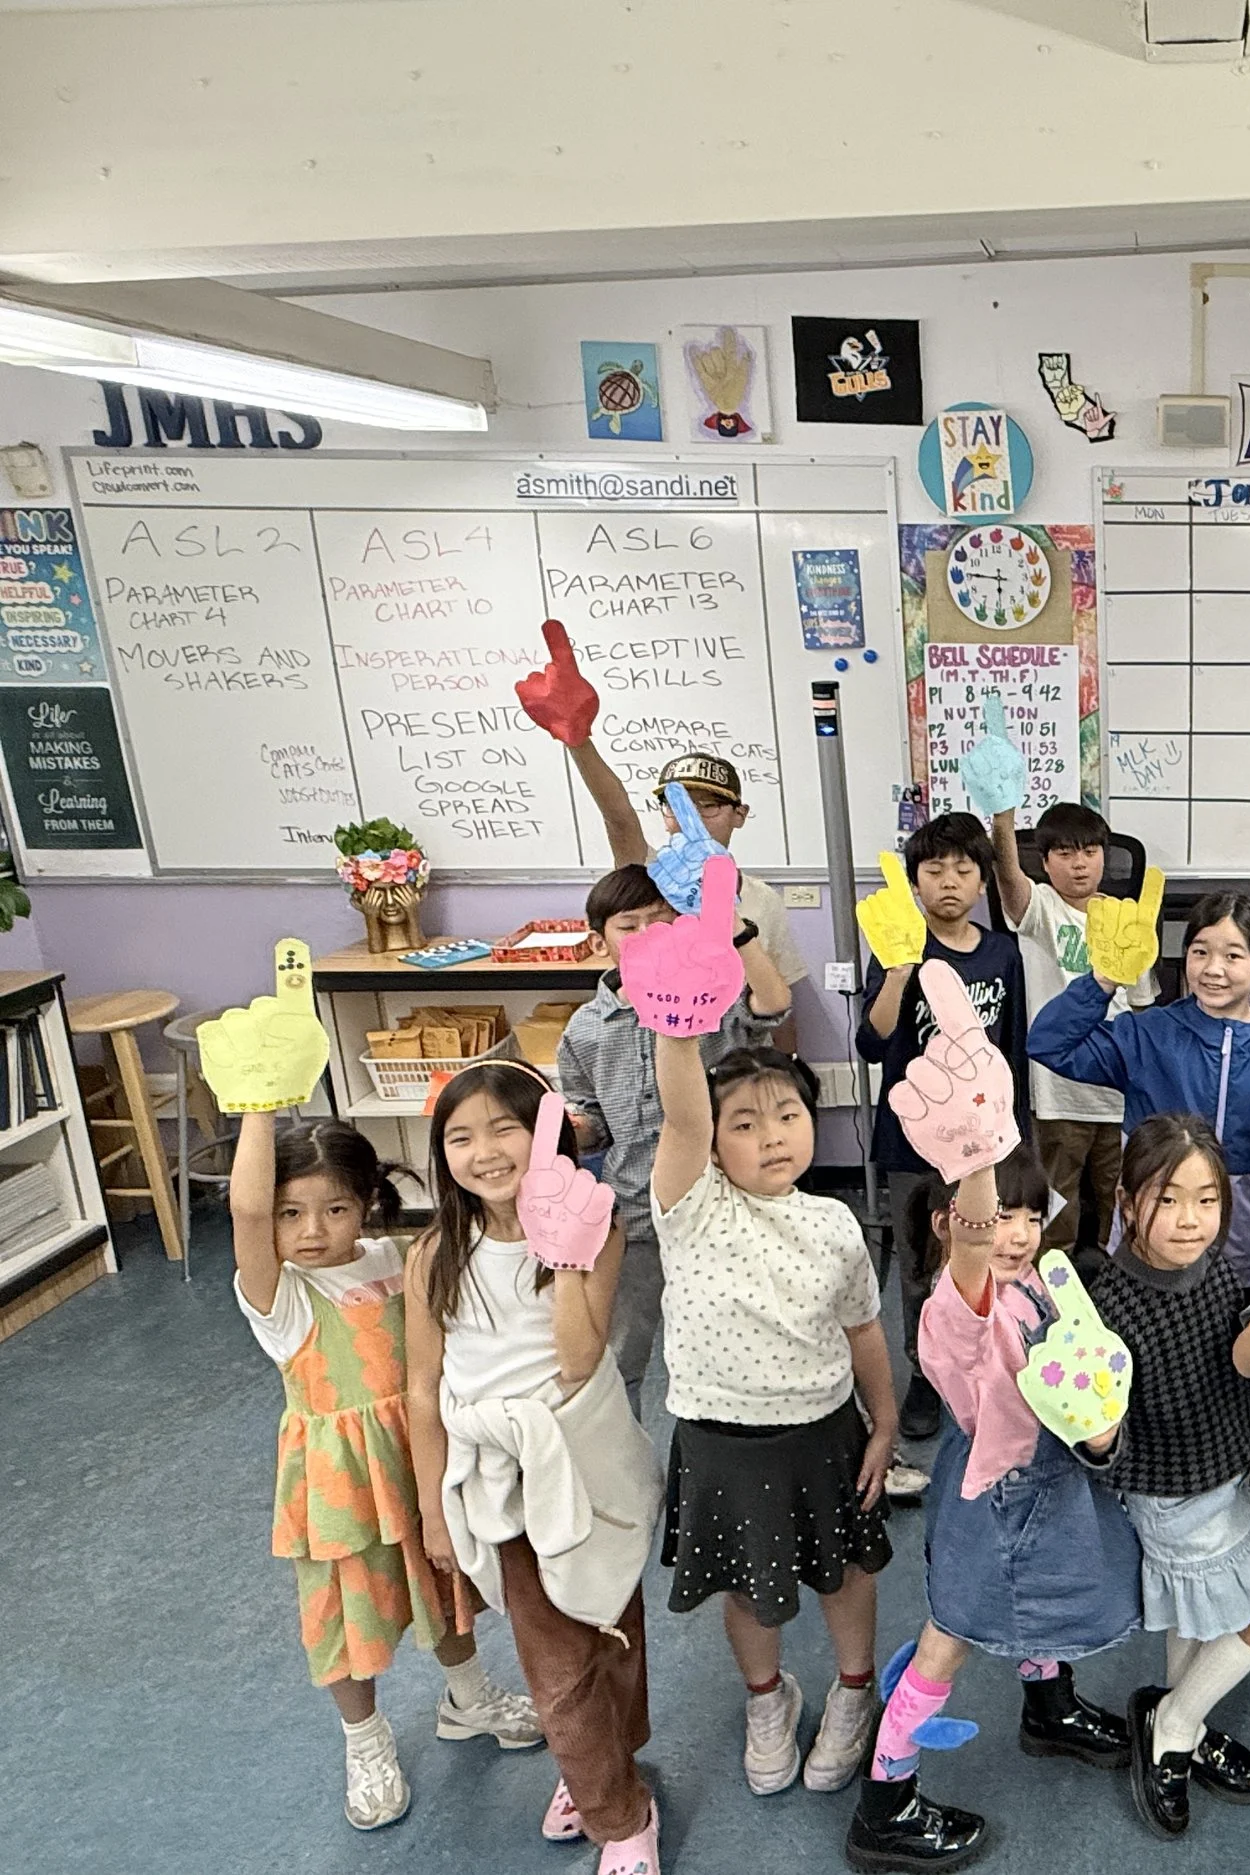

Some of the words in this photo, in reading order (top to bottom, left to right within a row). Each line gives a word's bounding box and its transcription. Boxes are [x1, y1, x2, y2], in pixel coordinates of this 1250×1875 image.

[942, 415, 1002, 448] STAY
[516, 473, 738, 499] asmith@sandi.net
[951, 480, 1013, 512] kind
[1134, 506, 1165, 520] MON
[7, 544, 32, 555] YOU
[34, 543, 73, 555] SPEAK!
[122, 520, 247, 557] ASL
[257, 527, 301, 552] 2
[361, 527, 462, 564] ASL
[464, 526, 493, 552] 4
[586, 523, 680, 554] ASL
[690, 526, 713, 551] 6
[991, 545, 1001, 554] 12
[970, 559, 980, 567] 10
[980, 549, 988, 558] 11
[106, 577, 260, 604] PARAMETER
[328, 576, 467, 601] PARAMETER
[547, 568, 745, 599] PARAMETER
[375, 599, 455, 623] CHART
[467, 599, 494, 616] 10
[589, 595, 678, 619] CHART
[689, 592, 719, 611] 13
[129, 610, 199, 630] CHART
[205, 606, 227, 627] 4
[118, 643, 242, 674] MOVERS
[258, 646, 312, 668] AND
[928, 645, 969, 669] BELL
[976, 644, 1061, 669] SCHEDULE
[164, 671, 311, 691] SHAKERS
[391, 673, 490, 692] PERSON
[604, 669, 723, 691] SKILLS
[929, 687, 942, 704] P1
[28, 702, 77, 728] Life
[944, 706, 1038, 721] NUTION
[602, 713, 732, 740] COMPARE
[929, 723, 947, 738] P2
[29, 741, 93, 754] MAKING
[398, 747, 467, 772] LIST
[482, 745, 527, 767] ON
[731, 743, 779, 762] CATS
[930, 740, 949, 756] P3
[1116, 738, 1156, 774] MLK
[29, 757, 100, 769] MISTAKES
[1131, 758, 1164, 789] DAY
[415, 775, 537, 799] GOOGLE
[930, 776, 949, 792] P4
[38, 788, 107, 814] Learning
[418, 798, 530, 819] SPREAD
[932, 797, 953, 813] P5
[43, 819, 78, 830] FROM
[81, 819, 115, 830] THEM
[450, 819, 545, 842] SHEET
[656, 993, 680, 1004] GOD
